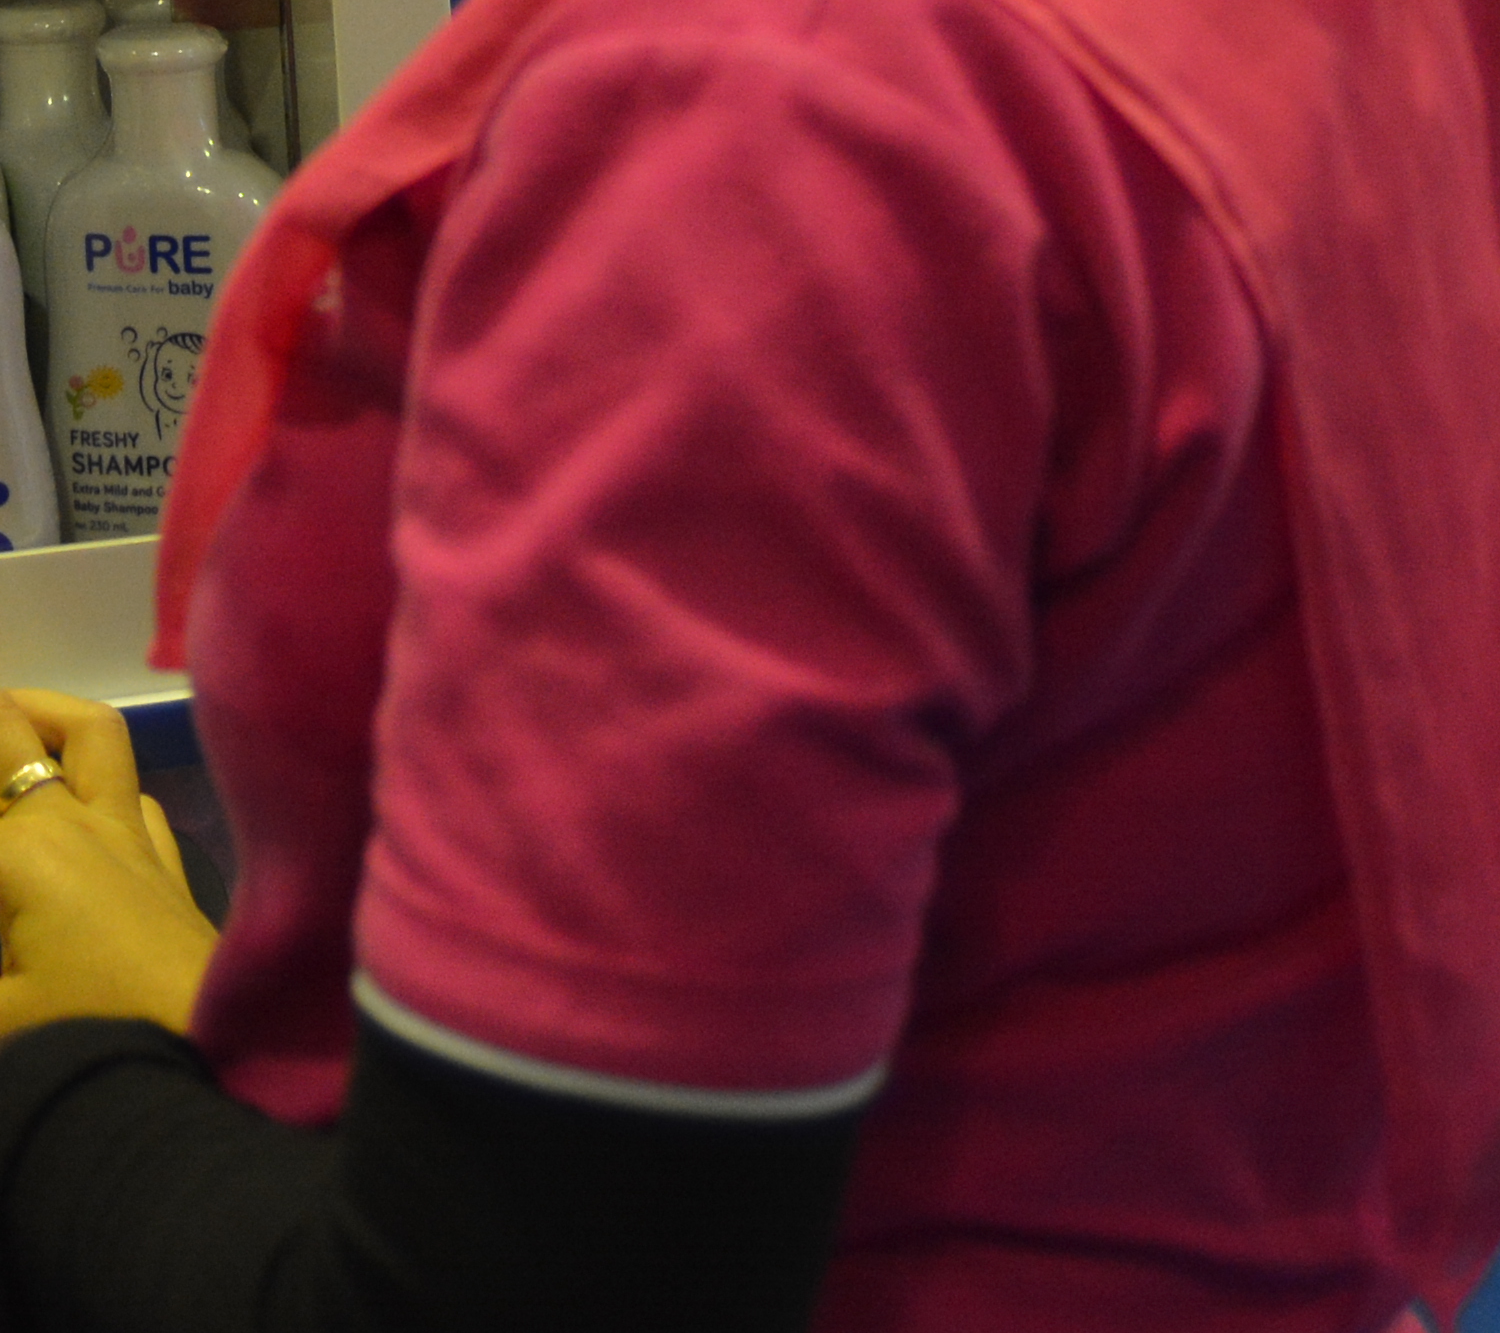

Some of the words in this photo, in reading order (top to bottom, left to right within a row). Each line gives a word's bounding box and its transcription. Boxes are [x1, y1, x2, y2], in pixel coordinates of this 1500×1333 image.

[85, 225, 213, 274] PURE
[168, 279, 214, 299] baby
[70, 430, 139, 448] FRESHY
[72, 452, 177, 477] SHAMPO
[72, 482, 100, 495] Extra
[104, 484, 128, 496] Mild
[131, 485, 153, 497] and
[73, 500, 100, 514] Baby
[103, 501, 159, 515] Shampoo
